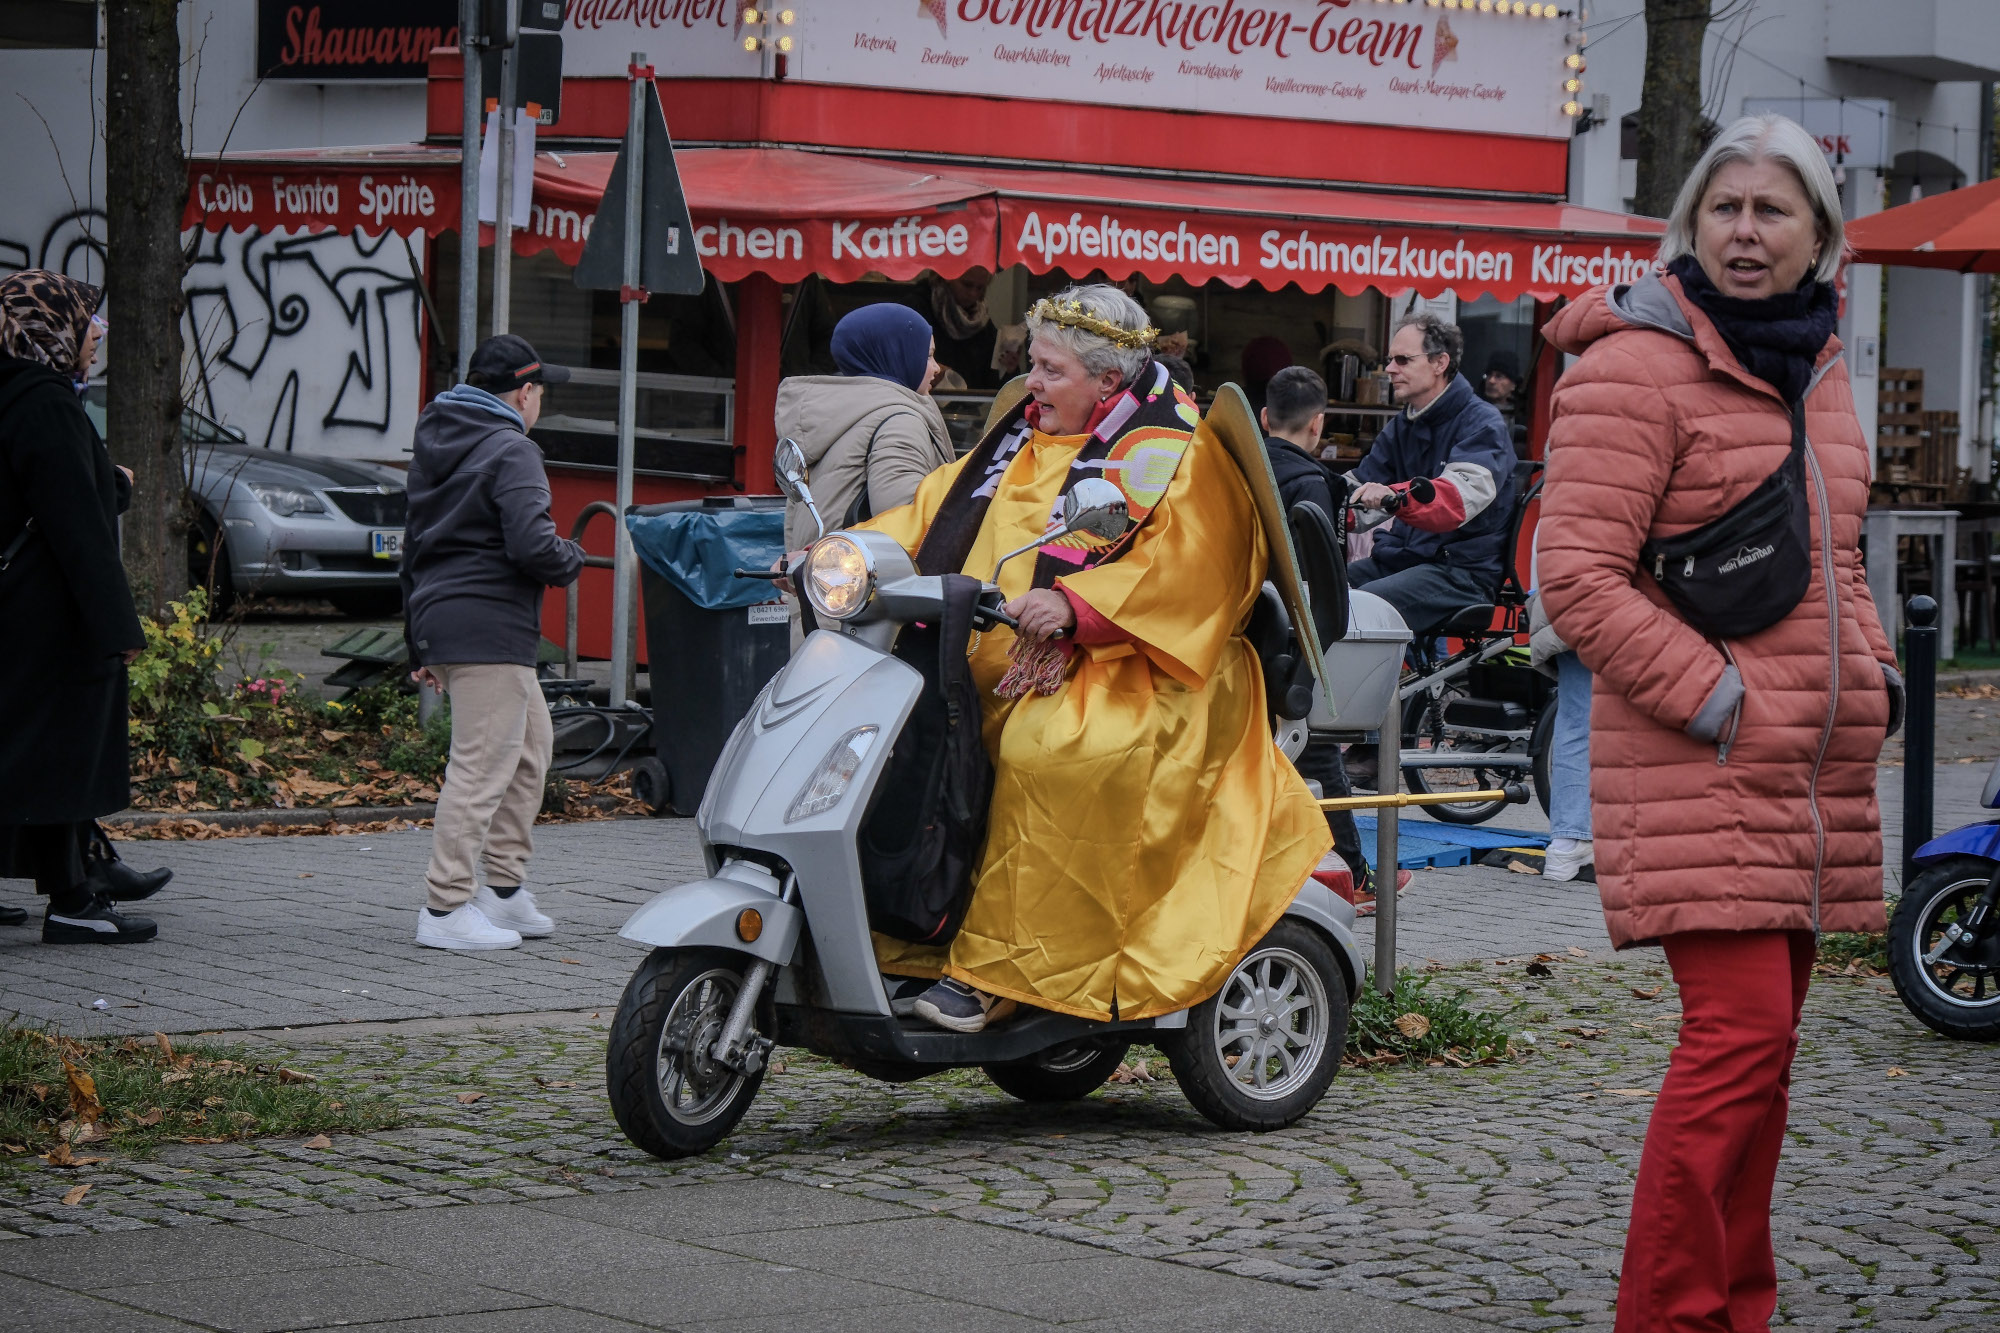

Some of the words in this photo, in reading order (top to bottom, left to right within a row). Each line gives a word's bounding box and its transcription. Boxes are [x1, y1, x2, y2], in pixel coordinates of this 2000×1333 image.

[853, 32, 897, 53] Victoria
[920, 47, 969, 68] Berliner
[993, 43, 1071, 68] Quarkbällchen
[1093, 61, 1155, 84] Apfeltasche
[1177, 59, 1244, 81] Kirschtasche
[1264, 76, 1367, 100] Vanillecreme-Tasche
[1388, 75, 1507, 101] Quark-Marzipan-Tasche
[198, 173, 254, 213] Cola
[272, 175, 339, 215] Fanta
[358, 174, 436, 226] Sprite
[695, 216, 803, 261] chen
[832, 215, 969, 260] Kaffee
[1016, 211, 1240, 267] Apfeltaschen
[1259, 228, 1513, 283] Schmalzkuchen
[1718, 561, 1738, 574] HIGH
